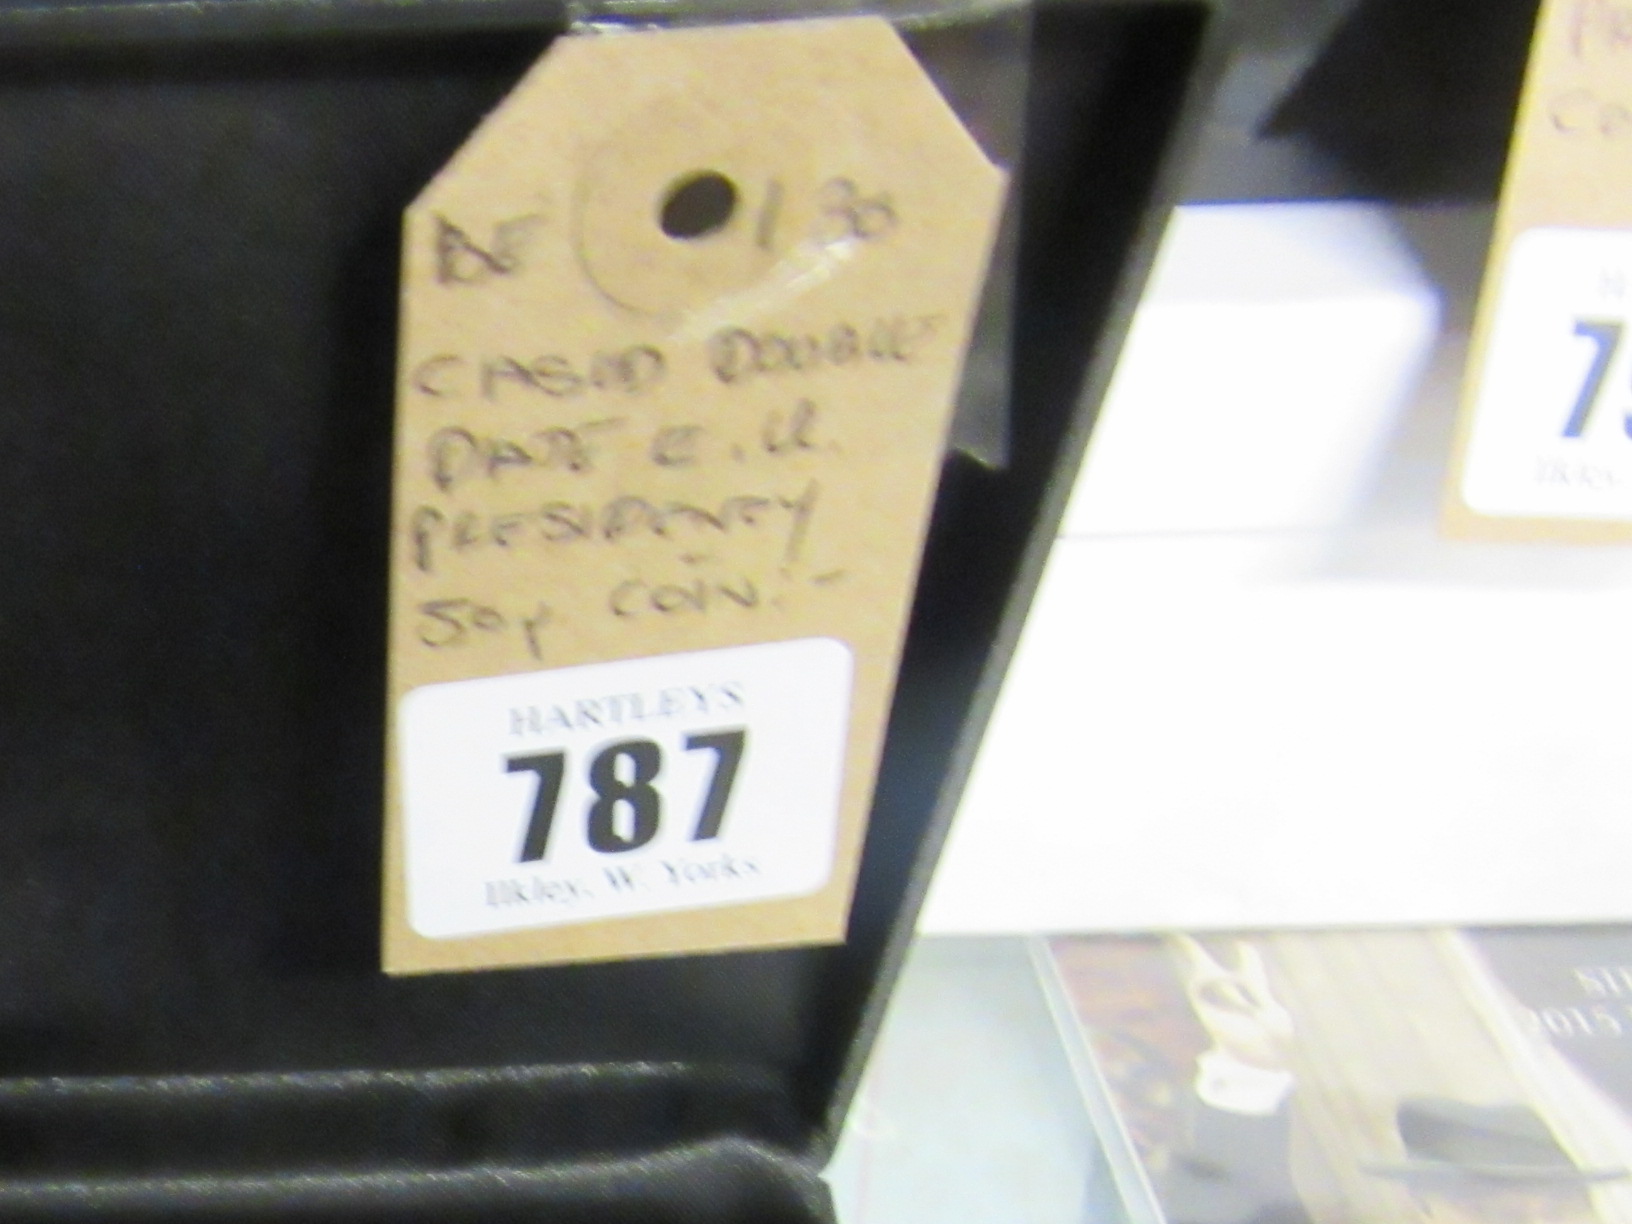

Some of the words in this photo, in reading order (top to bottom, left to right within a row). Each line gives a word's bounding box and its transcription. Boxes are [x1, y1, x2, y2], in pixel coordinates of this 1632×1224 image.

[508, 680, 746, 736] HARTLEYS
[502, 722, 750, 864] 787
[660, 853, 762, 890] Yorks
